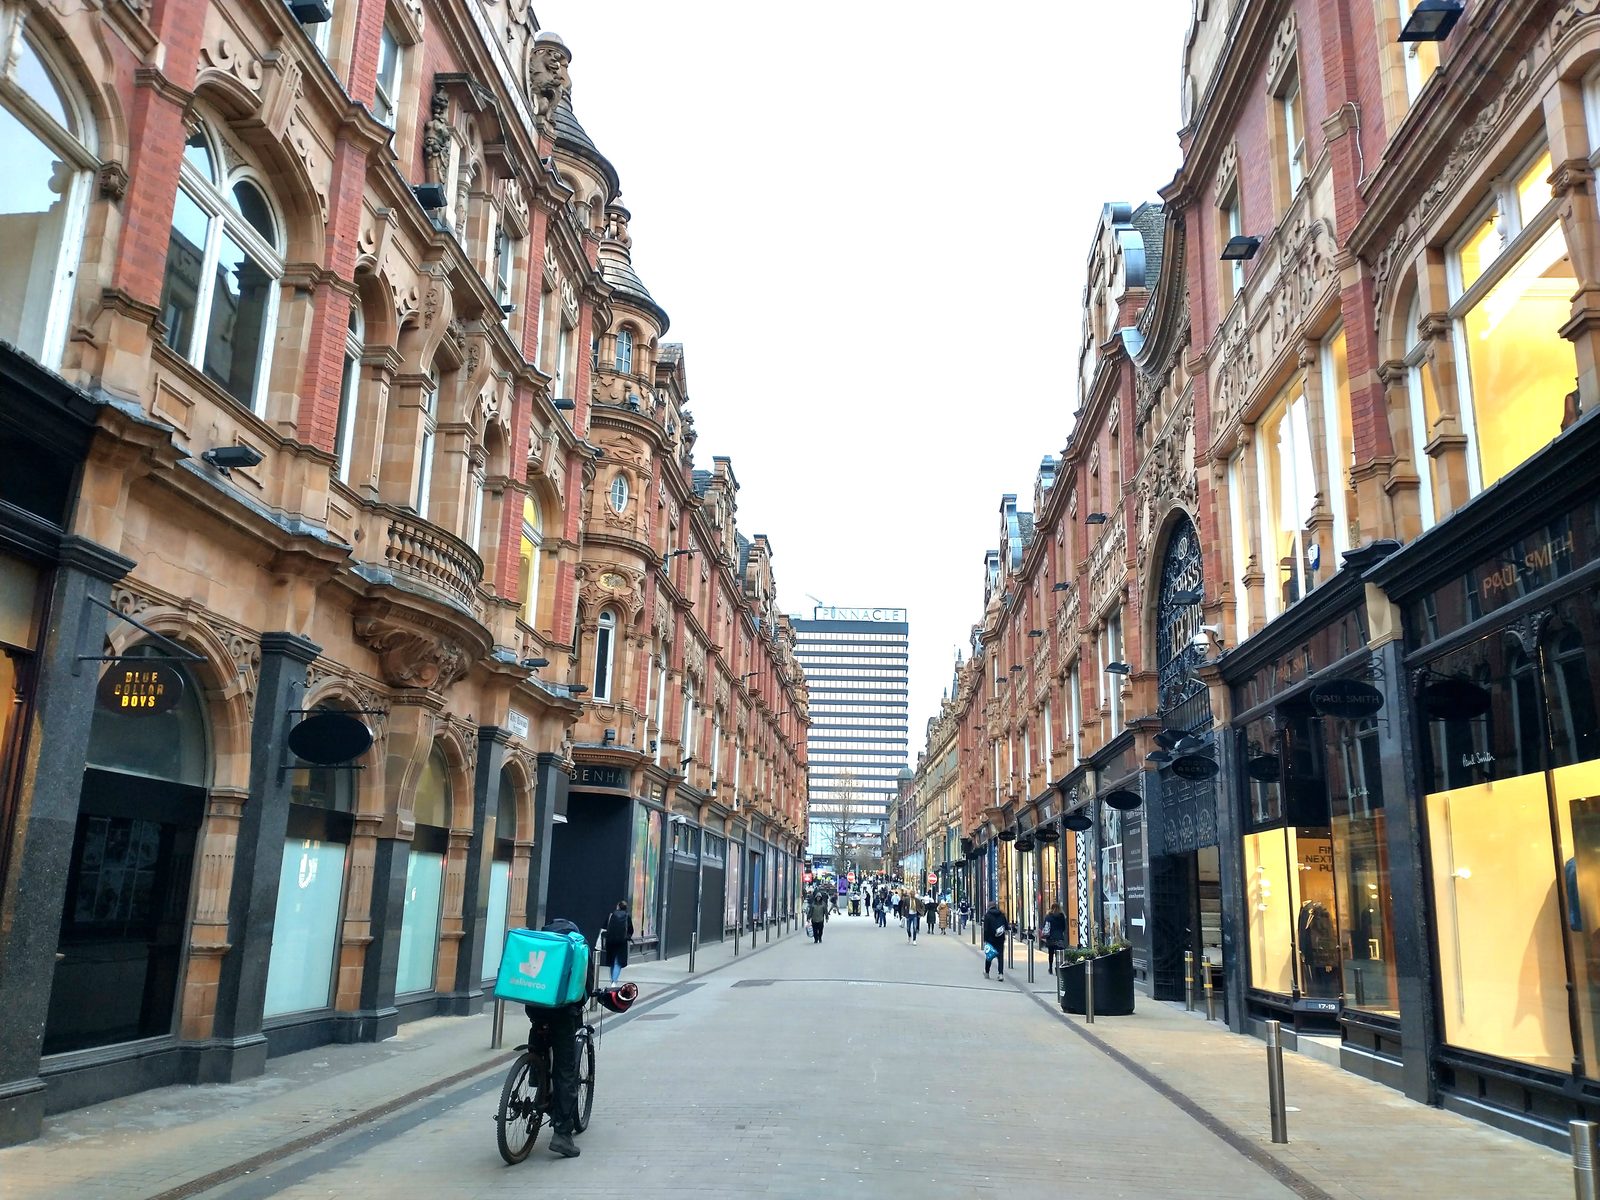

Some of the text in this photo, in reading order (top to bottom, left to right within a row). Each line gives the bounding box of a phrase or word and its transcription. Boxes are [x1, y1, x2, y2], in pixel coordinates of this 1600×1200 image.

[1483, 530, 1574, 599] PAUL SMITH
[823, 605, 899, 620] PINNACLE
[125, 672, 159, 683] BLUE
[114, 684, 164, 695] COLLAR
[121, 695, 156, 707] BOYS
[1346, 694, 1380, 704] SMITH
[1462, 751, 1496, 767] Paul Smith
